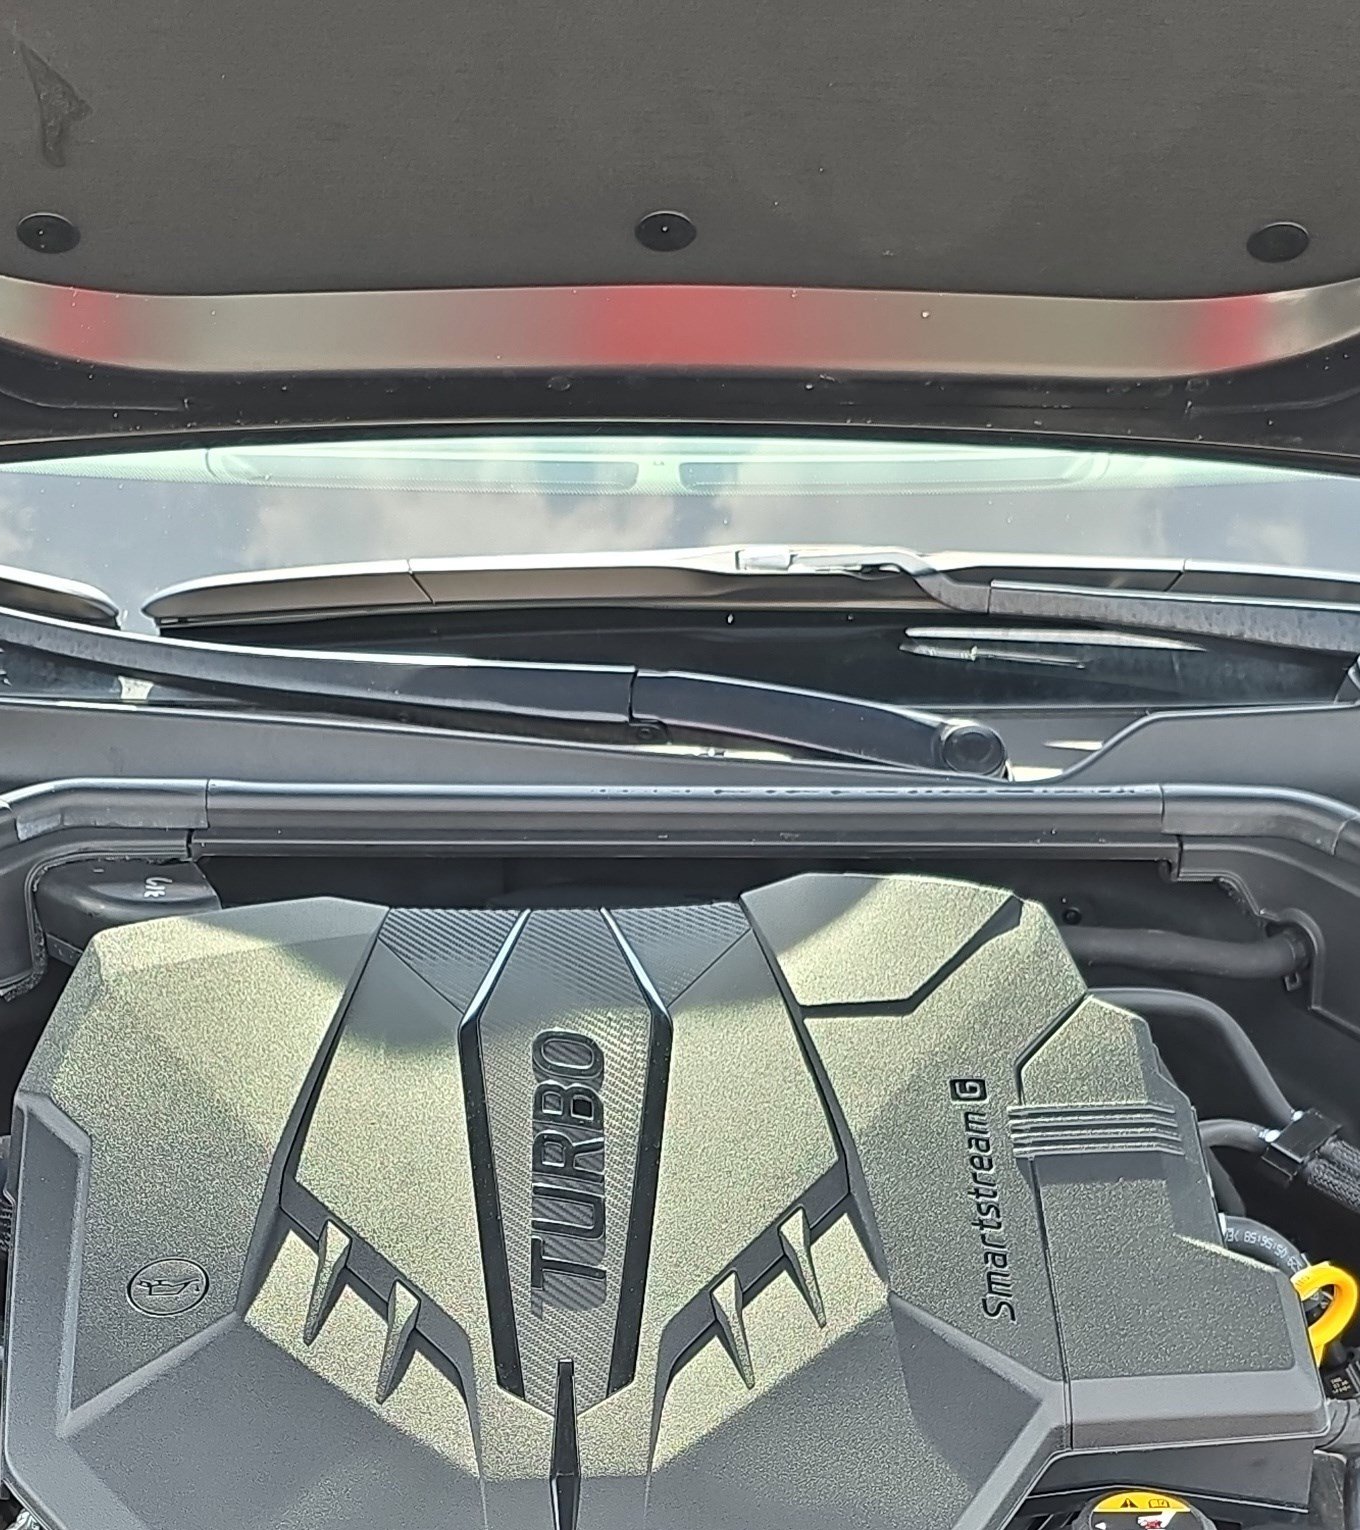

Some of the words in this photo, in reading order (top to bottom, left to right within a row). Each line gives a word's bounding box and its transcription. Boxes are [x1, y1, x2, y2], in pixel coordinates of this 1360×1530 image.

[530, 1029, 607, 1306] TURBO
[949, 1078, 988, 1100] G
[964, 1112, 1017, 1322] Smartstream
